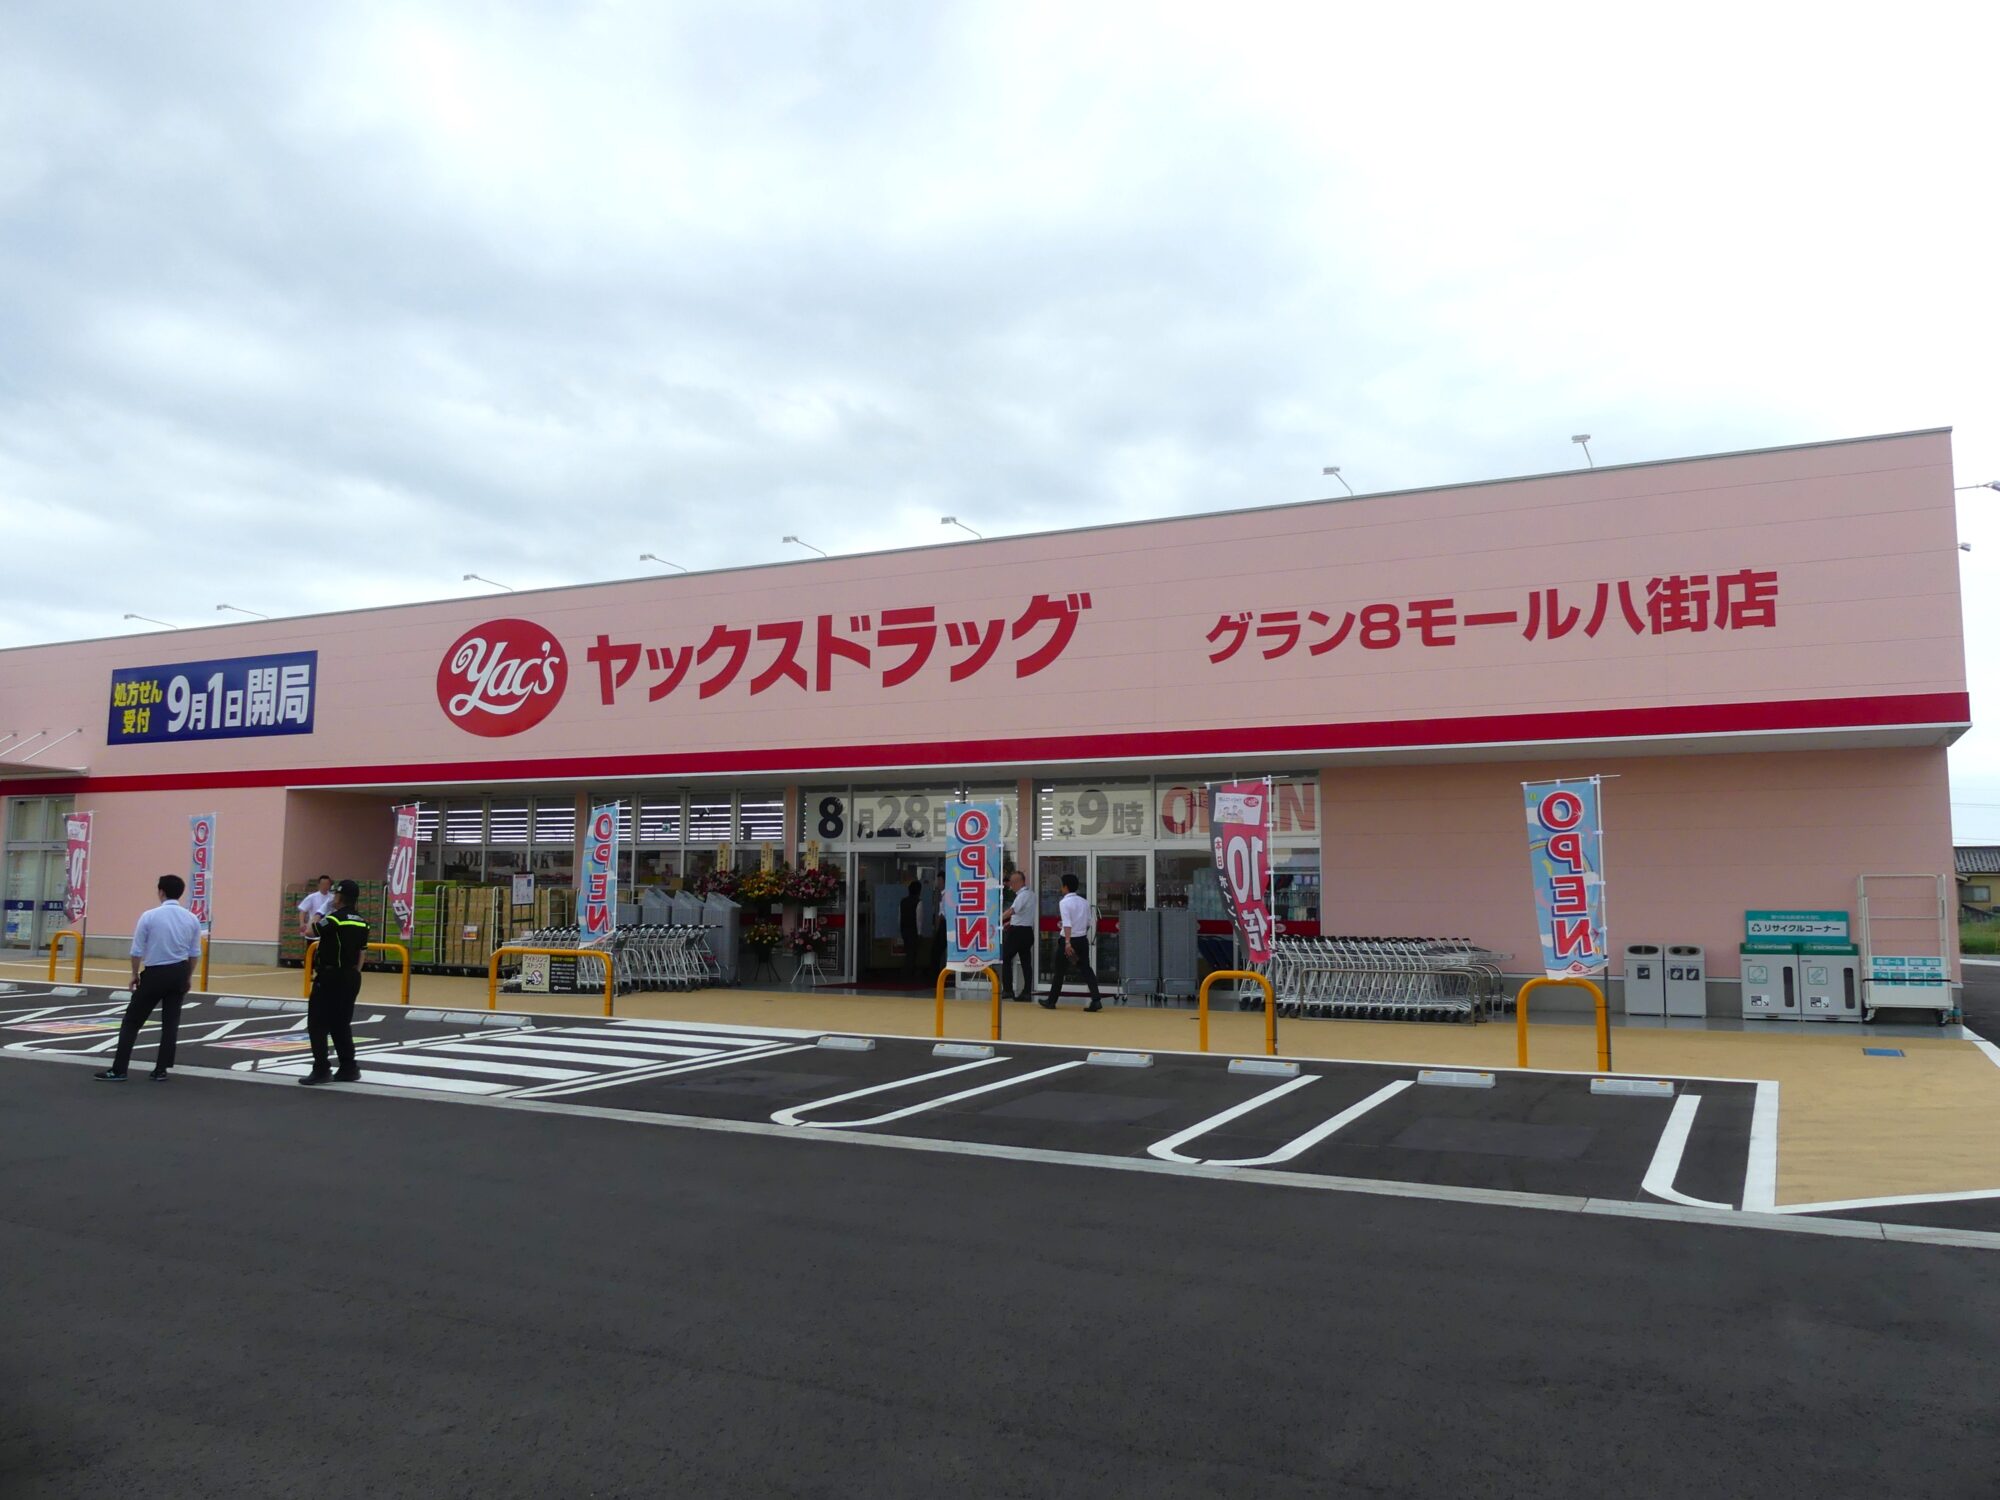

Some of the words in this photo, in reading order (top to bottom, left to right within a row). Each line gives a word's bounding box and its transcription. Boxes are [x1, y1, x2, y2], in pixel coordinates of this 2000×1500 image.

[586, 592, 1092, 705] ヤックスドラッグ
[1205, 569, 1778, 664] グラン8モール八街店
[113, 680, 163, 707] 処方せん
[167, 664, 310, 733] 9月1日開局
[449, 637, 560, 716] Yac's
[123, 708, 150, 734] 受付
[1764, 924, 1841, 933] リサイクルコーナー
